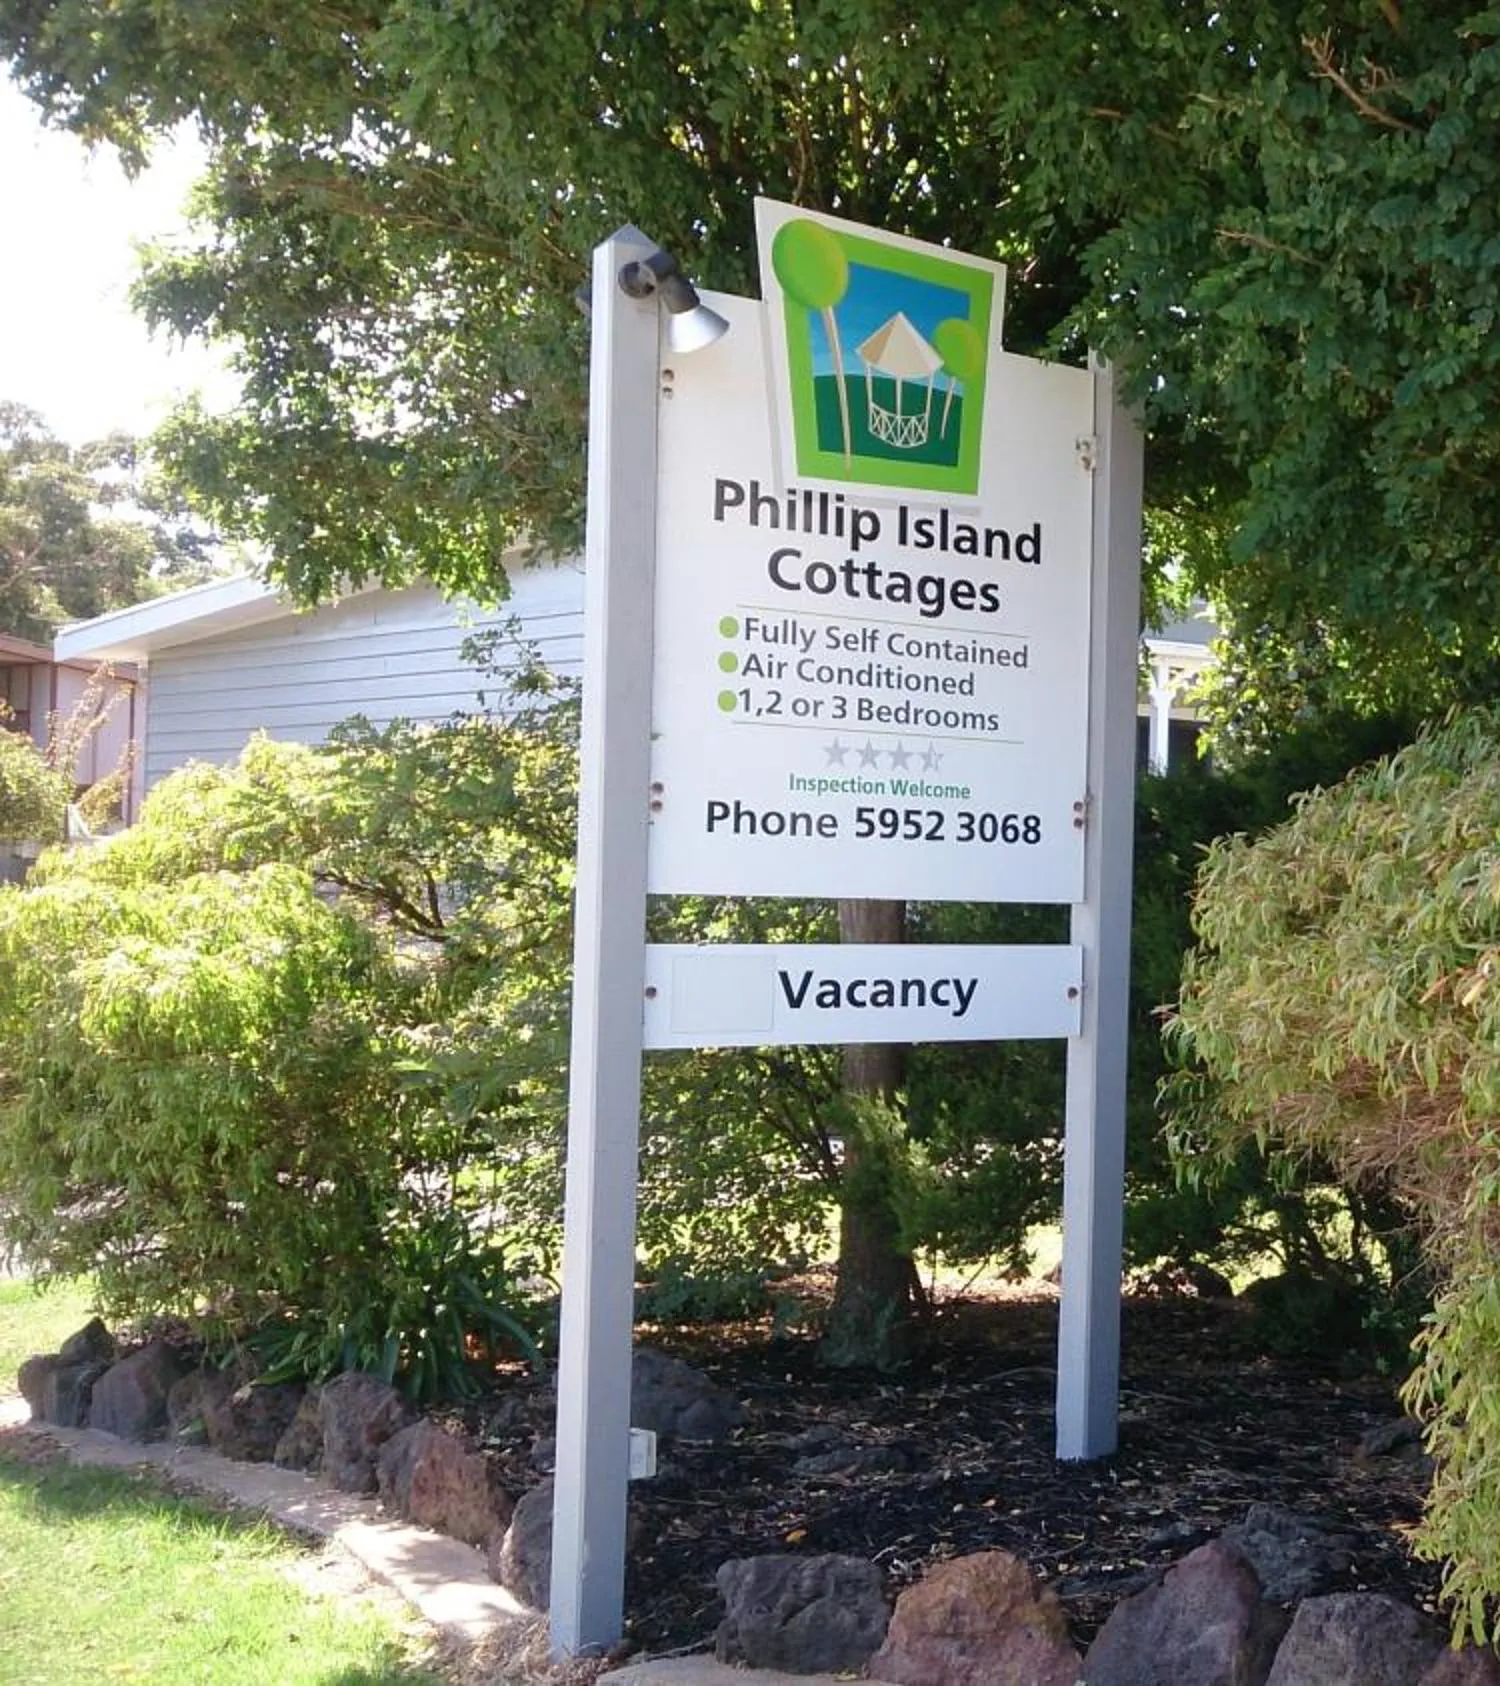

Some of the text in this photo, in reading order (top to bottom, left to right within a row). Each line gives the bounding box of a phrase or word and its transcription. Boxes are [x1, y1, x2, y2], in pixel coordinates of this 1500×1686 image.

[713, 478, 1042, 564] Phillip Island
[768, 547, 1002, 617] Cottages
[744, 617, 1028, 668] Fully Self Contained
[741, 653, 975, 697] Air Conditioned
[792, 698, 825, 719] or
[831, 695, 847, 719] 3
[857, 698, 999, 731] Bedrooms
[789, 773, 971, 800] Inspection Welcome
[706, 800, 1042, 844] Phone 5952 3068
[778, 970, 979, 1017] Vacancy
